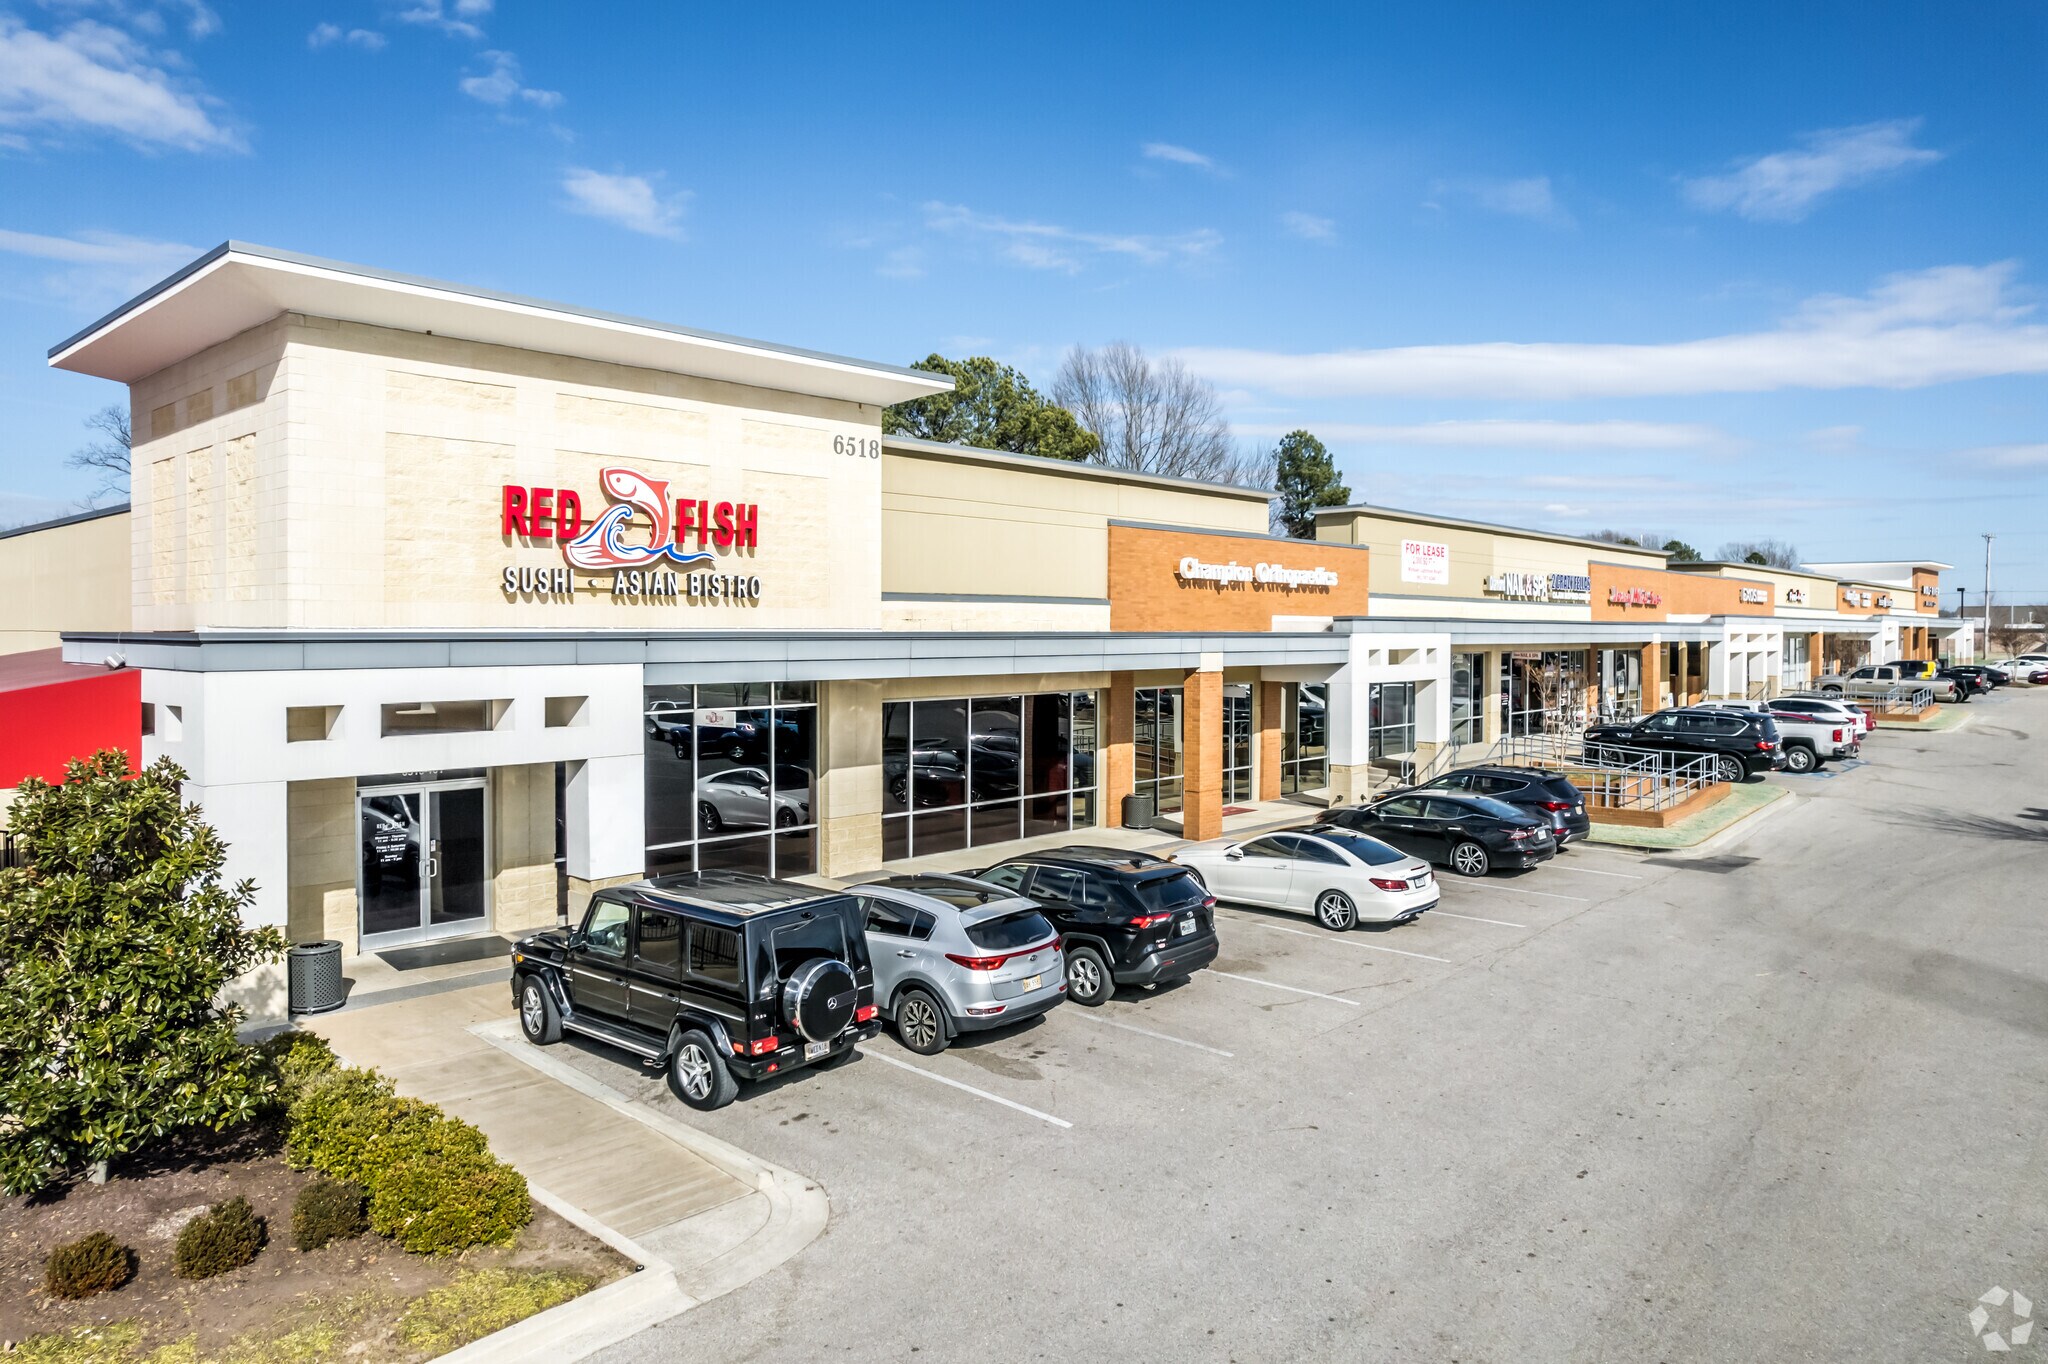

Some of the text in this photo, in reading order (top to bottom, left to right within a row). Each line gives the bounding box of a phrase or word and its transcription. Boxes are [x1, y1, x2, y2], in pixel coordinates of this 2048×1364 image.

[833, 434, 880, 459] 6518
[502, 484, 758, 547] RED FISH
[1405, 543, 1445, 557] FOR LEASE
[502, 566, 761, 599] SUSHI ASIAN BISTRO
[1504, 573, 1525, 596] NAIL
[1525, 575, 1533, 597] &
[1532, 575, 1548, 597] SPA
